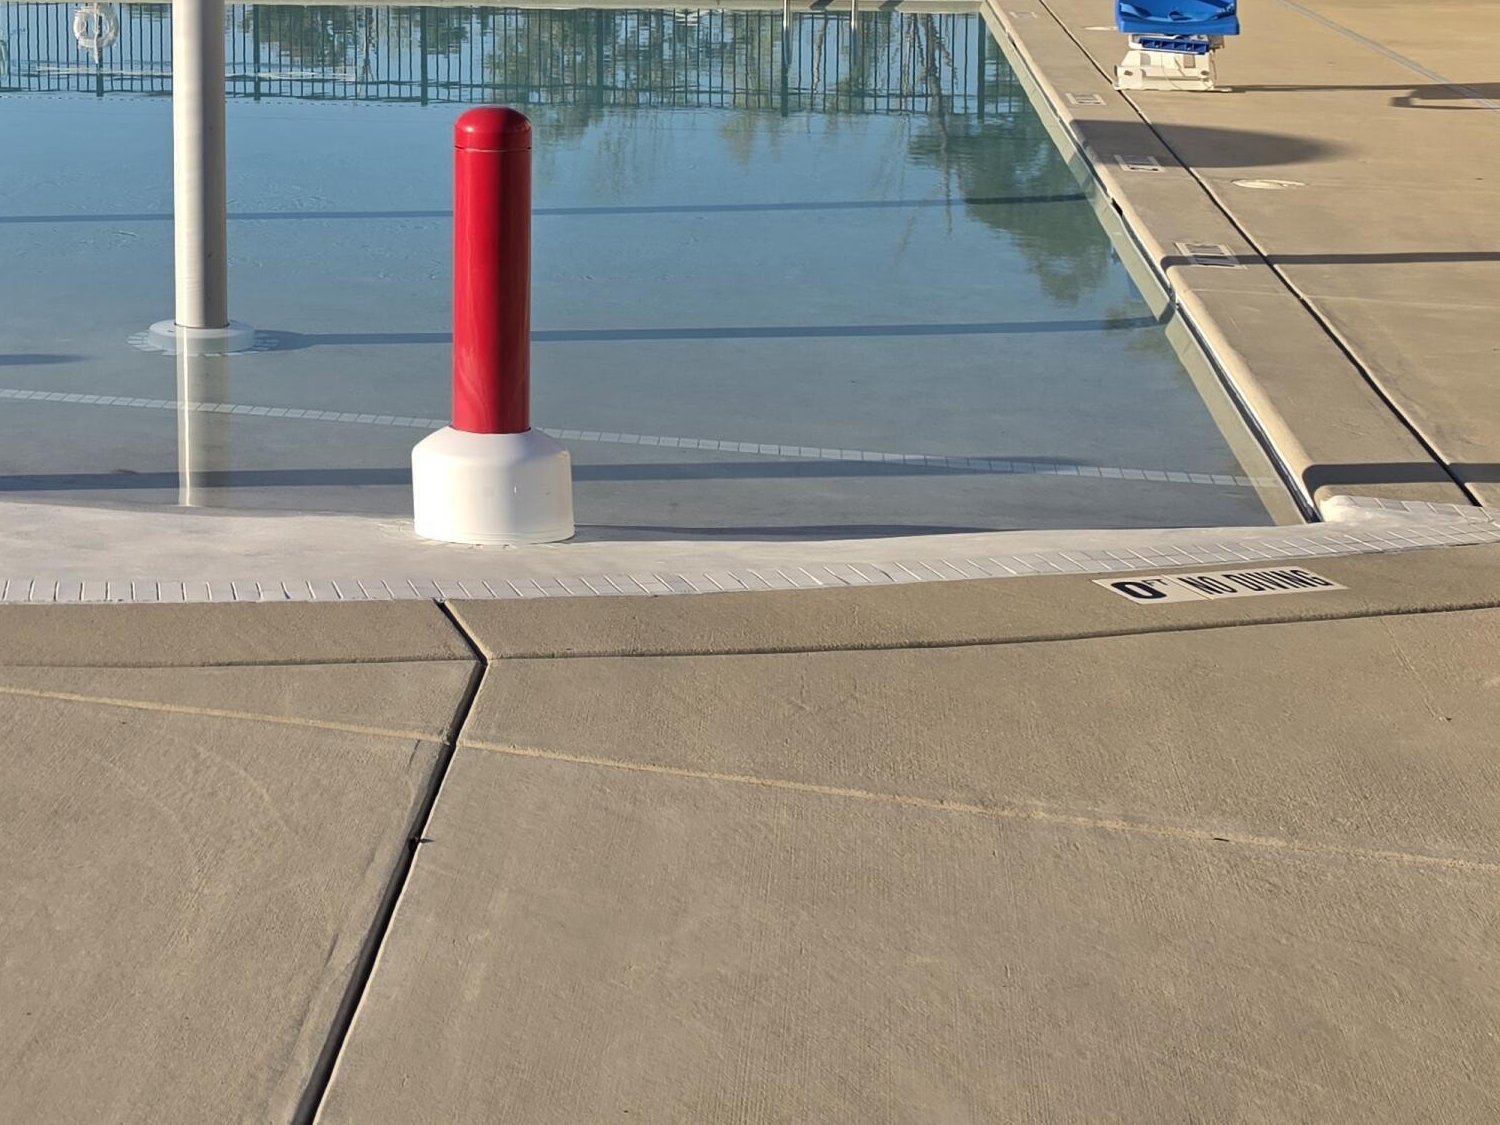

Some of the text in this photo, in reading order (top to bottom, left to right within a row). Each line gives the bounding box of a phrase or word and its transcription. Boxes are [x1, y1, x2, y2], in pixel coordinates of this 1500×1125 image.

[1111, 578, 1169, 600] 0 FT
[1177, 569, 1334, 595] NO DIVING
